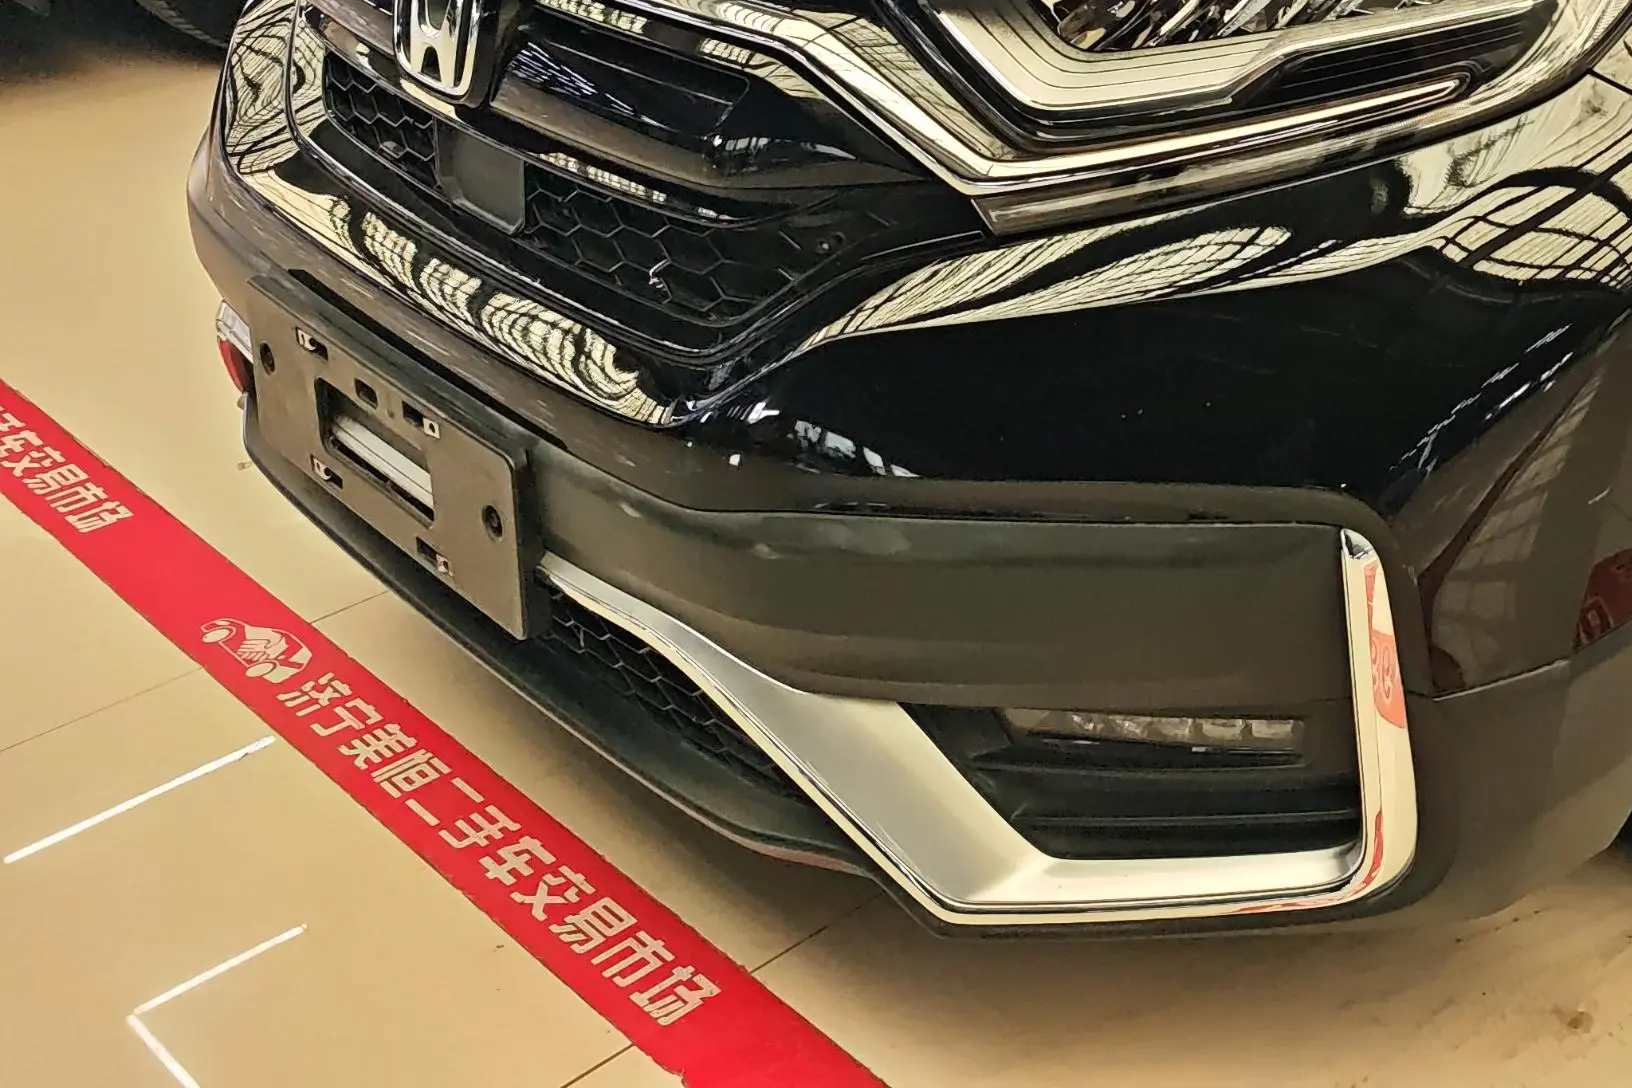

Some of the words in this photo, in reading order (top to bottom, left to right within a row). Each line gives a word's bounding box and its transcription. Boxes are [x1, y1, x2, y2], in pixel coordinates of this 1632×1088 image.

[276, 672, 722, 1027] 济宁美恒二手车交易市场
